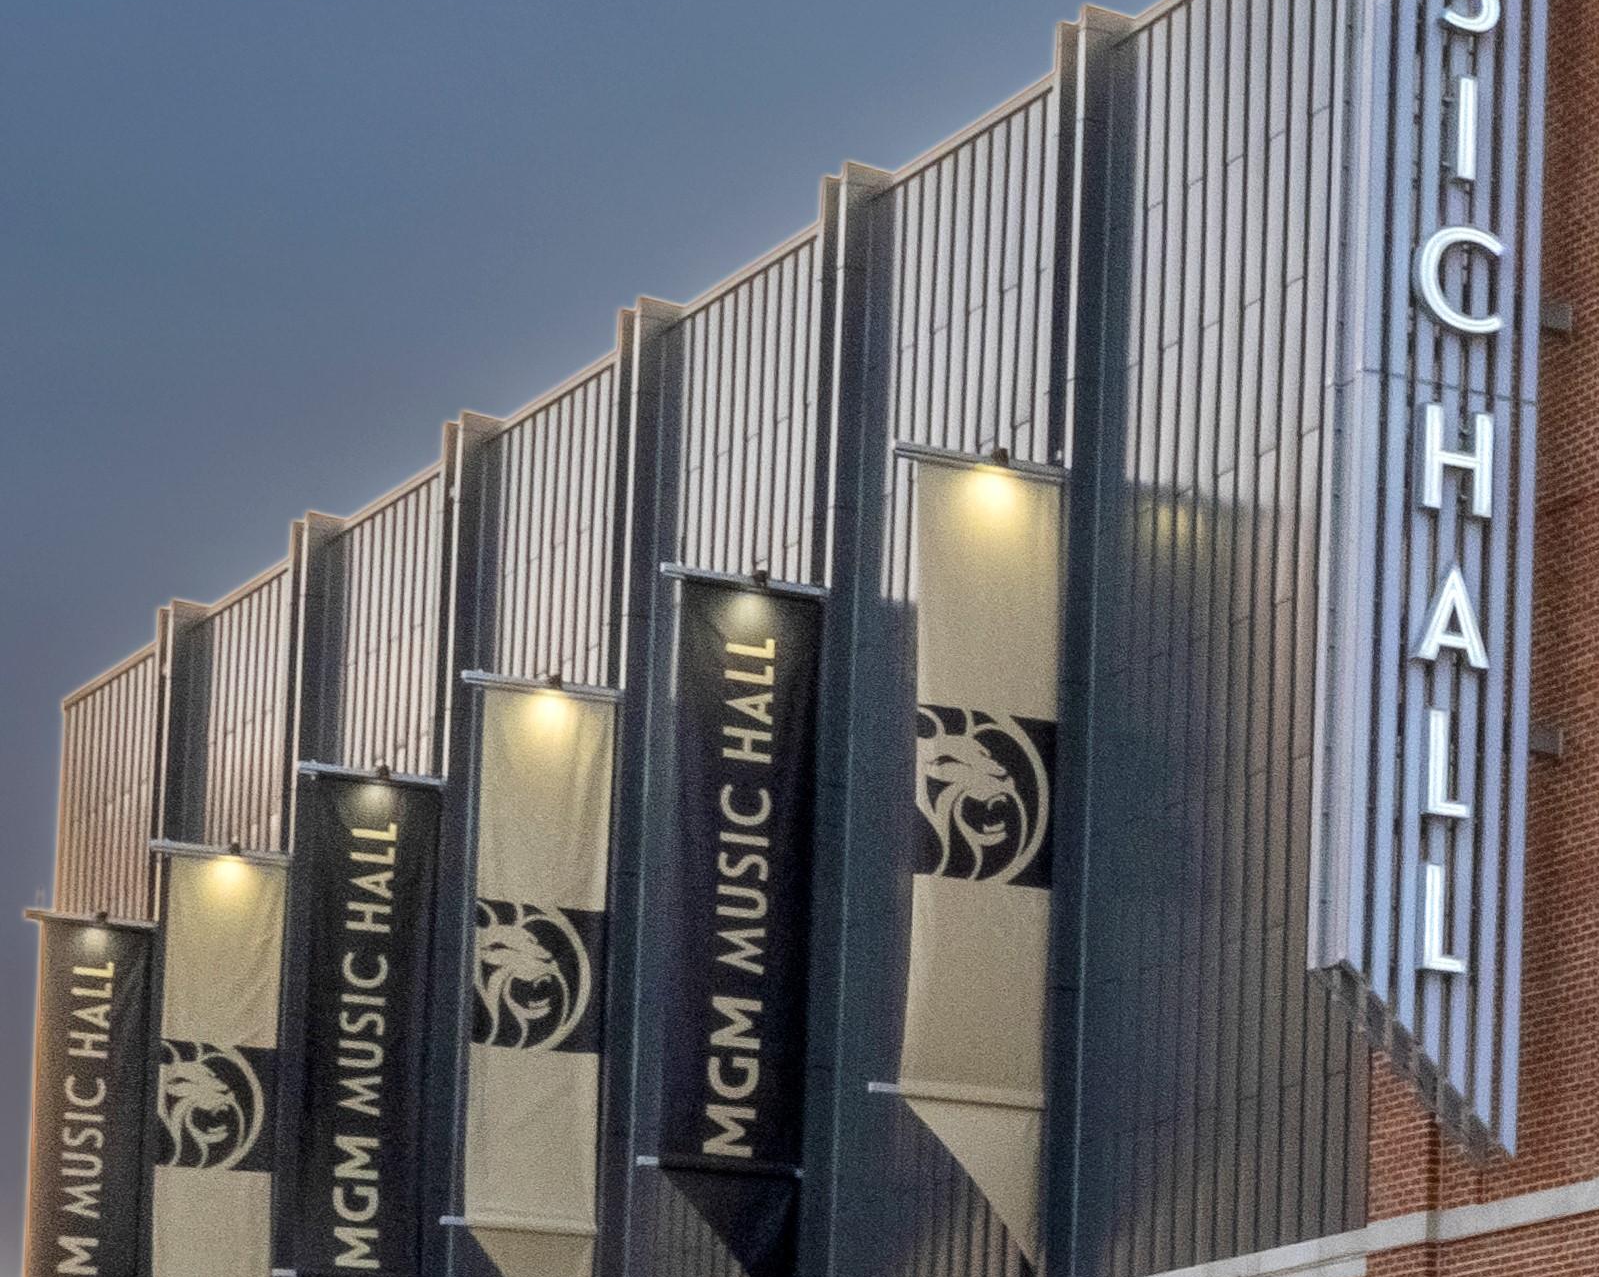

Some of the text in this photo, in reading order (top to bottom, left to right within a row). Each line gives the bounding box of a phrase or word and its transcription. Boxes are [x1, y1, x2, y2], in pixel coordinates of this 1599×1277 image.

[702, 635, 777, 1159] MGM MUSIC HALL
[1412, 400, 1494, 976] HALL
[62, 1072, 108, 1221] MUSIC
[68, 960, 116, 1060] HALL
[332, 822, 398, 1270] MGM MUSIC HALL
